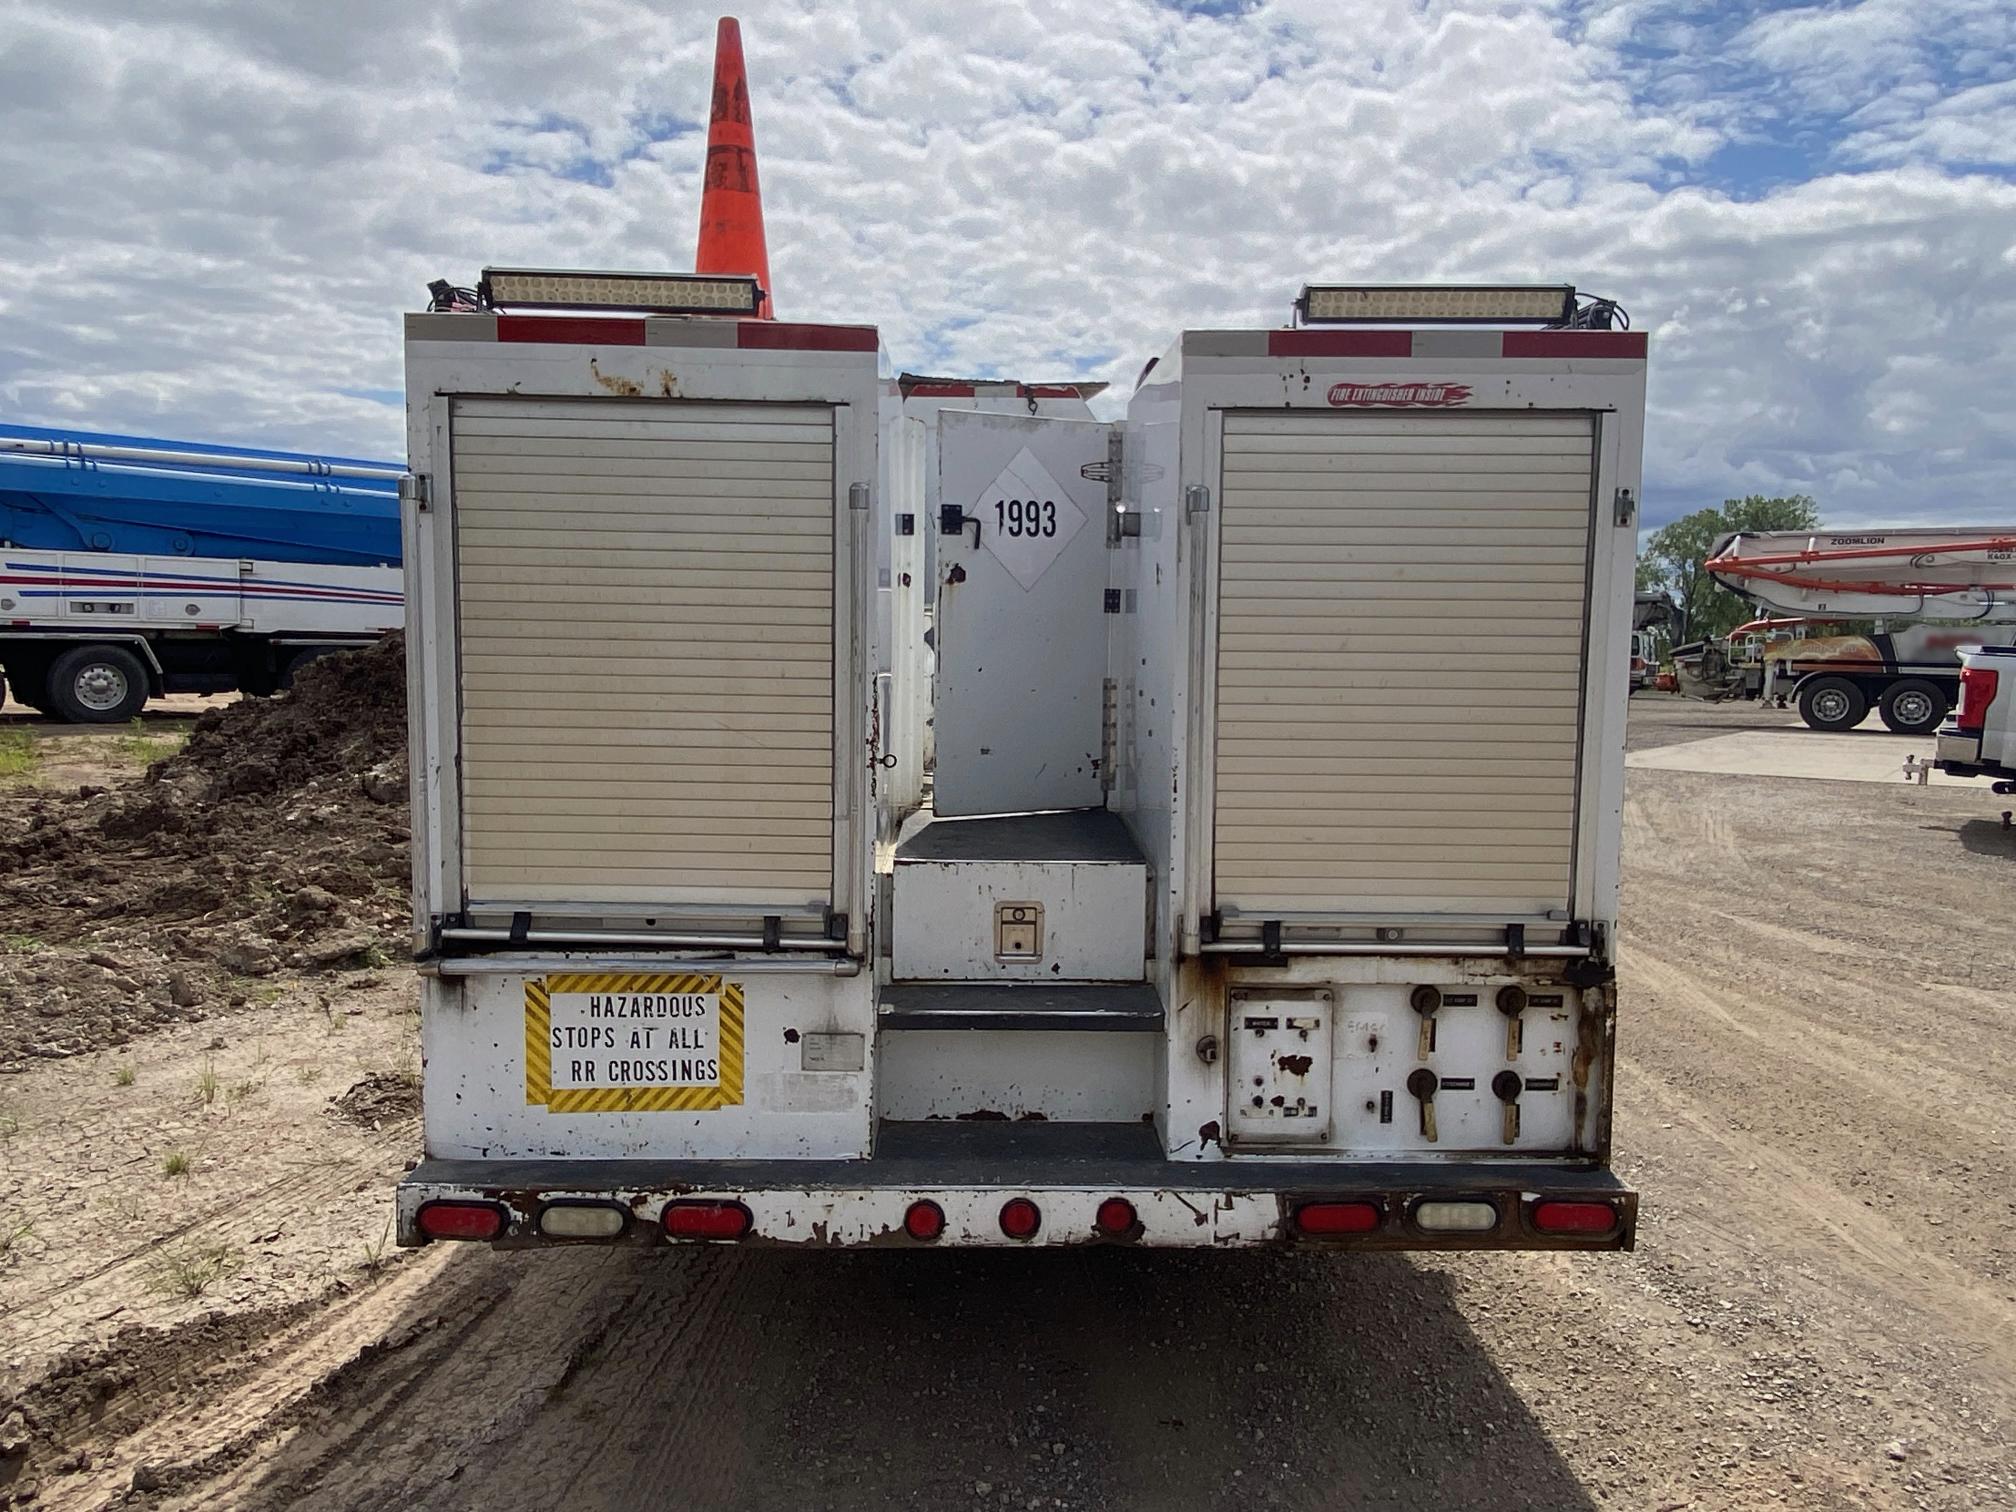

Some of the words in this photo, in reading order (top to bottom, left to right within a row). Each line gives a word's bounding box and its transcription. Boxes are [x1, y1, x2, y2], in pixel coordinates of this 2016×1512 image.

[1331, 388, 1351, 401] FIRE
[1352, 388, 1415, 401] EXTINGUISHER
[1416, 388, 1446, 401] INSIDE
[994, 500, 1056, 537] 1993
[1830, 537, 1885, 545] ZOOMLION
[589, 996, 706, 1018] HAZARDOUS
[552, 1027, 615, 1049] STOPS
[629, 1027, 659, 1049] AT
[668, 1027, 704, 1050] ALL
[571, 1060, 596, 1082] RR
[608, 1059, 718, 1082] CROSSINGS
